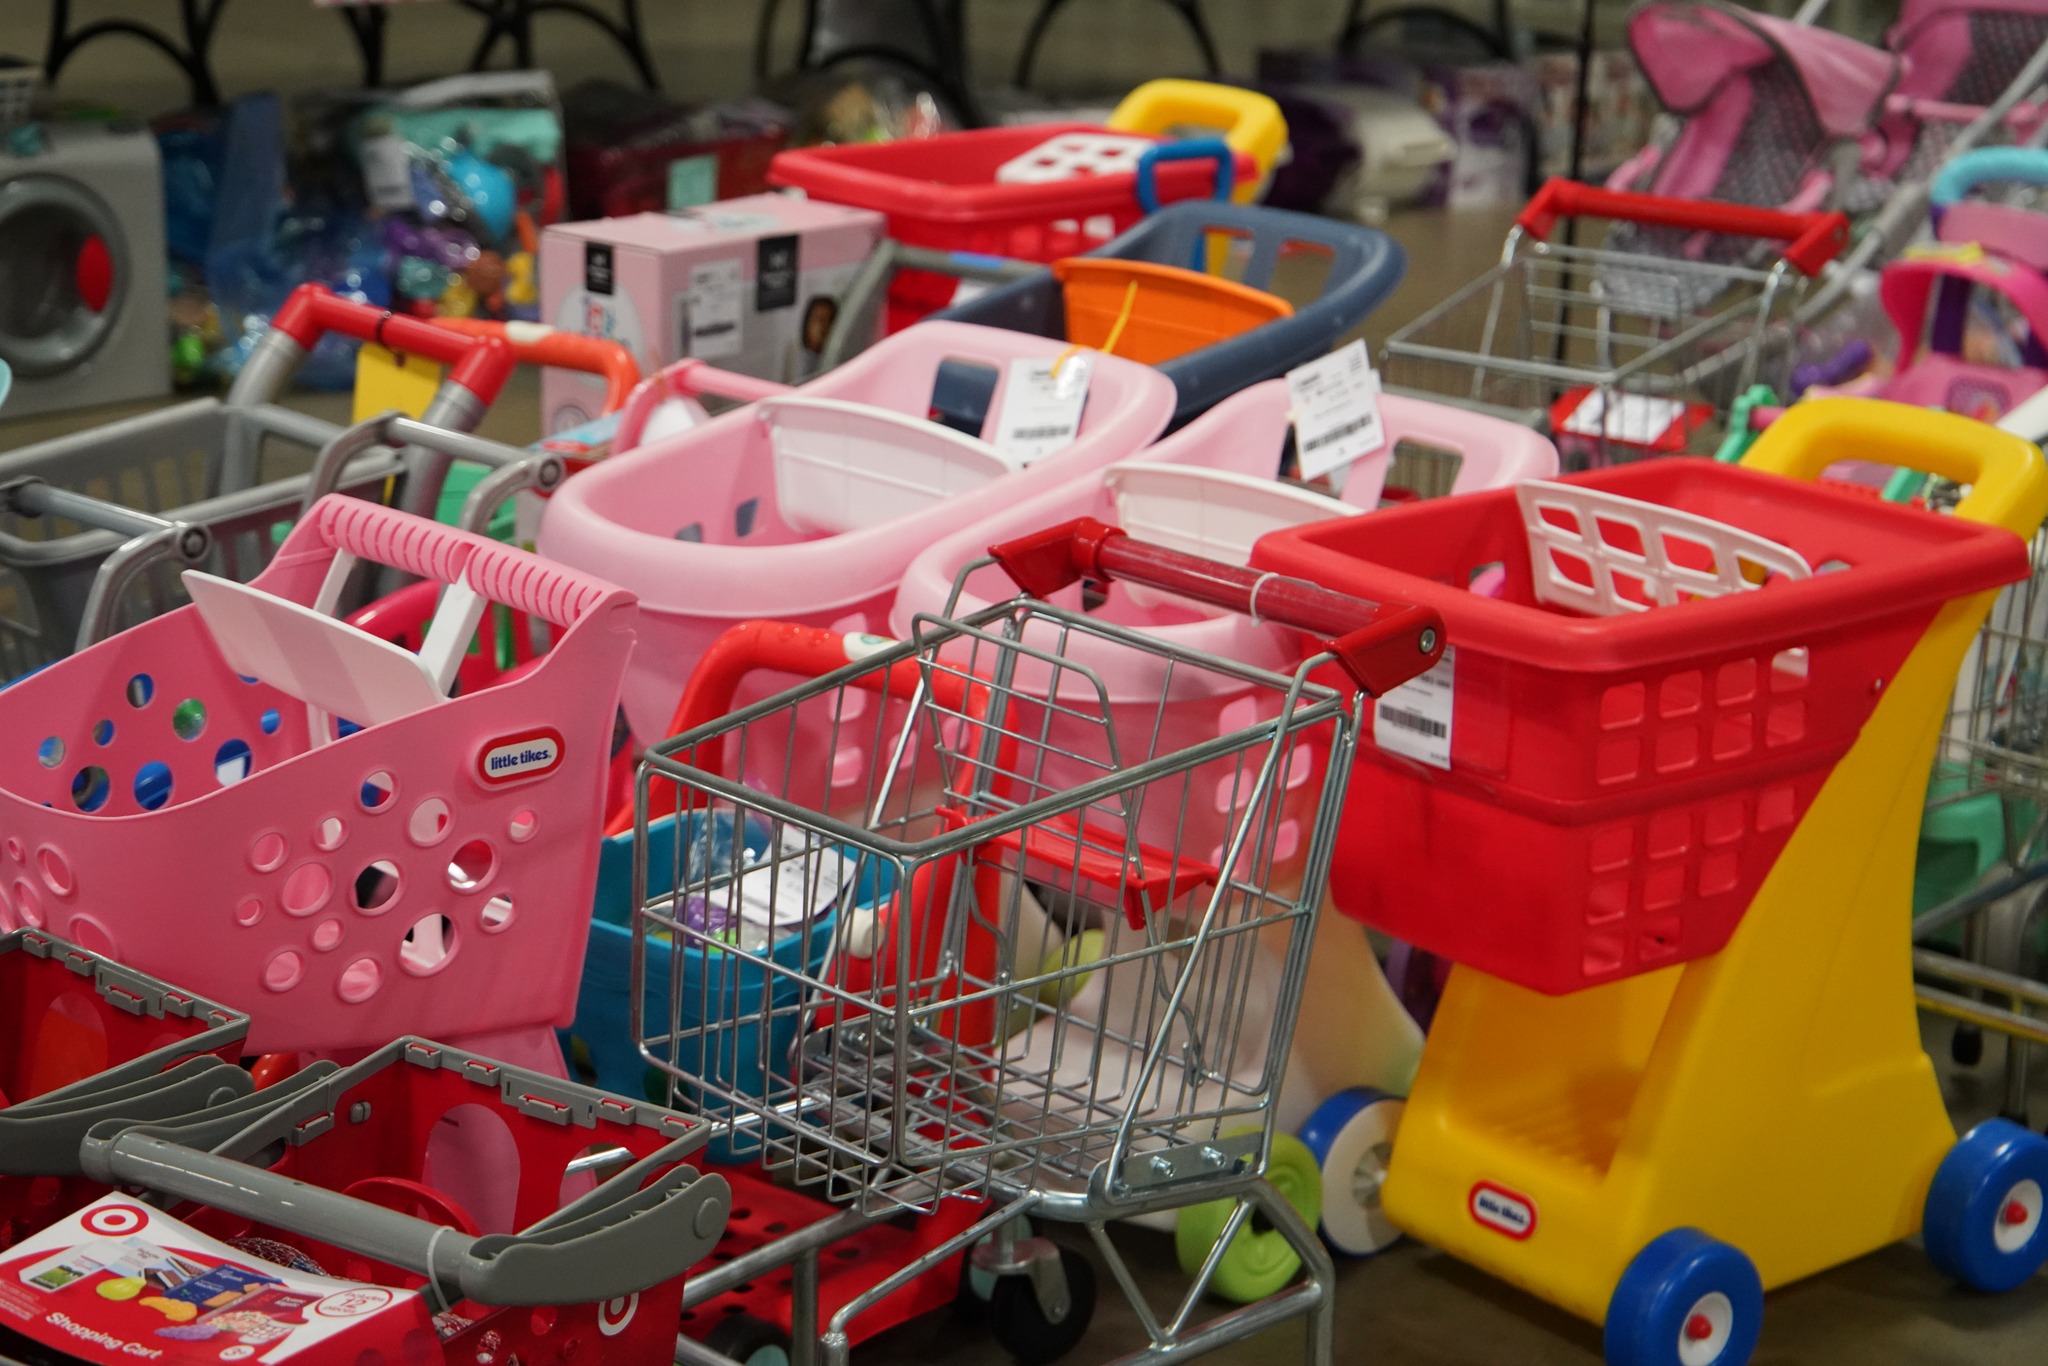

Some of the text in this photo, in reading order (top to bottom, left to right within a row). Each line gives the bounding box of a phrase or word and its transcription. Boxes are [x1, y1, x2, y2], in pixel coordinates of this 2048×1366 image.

[491, 754, 518, 770] little
[46, 1312, 163, 1360] Shopping Cart
